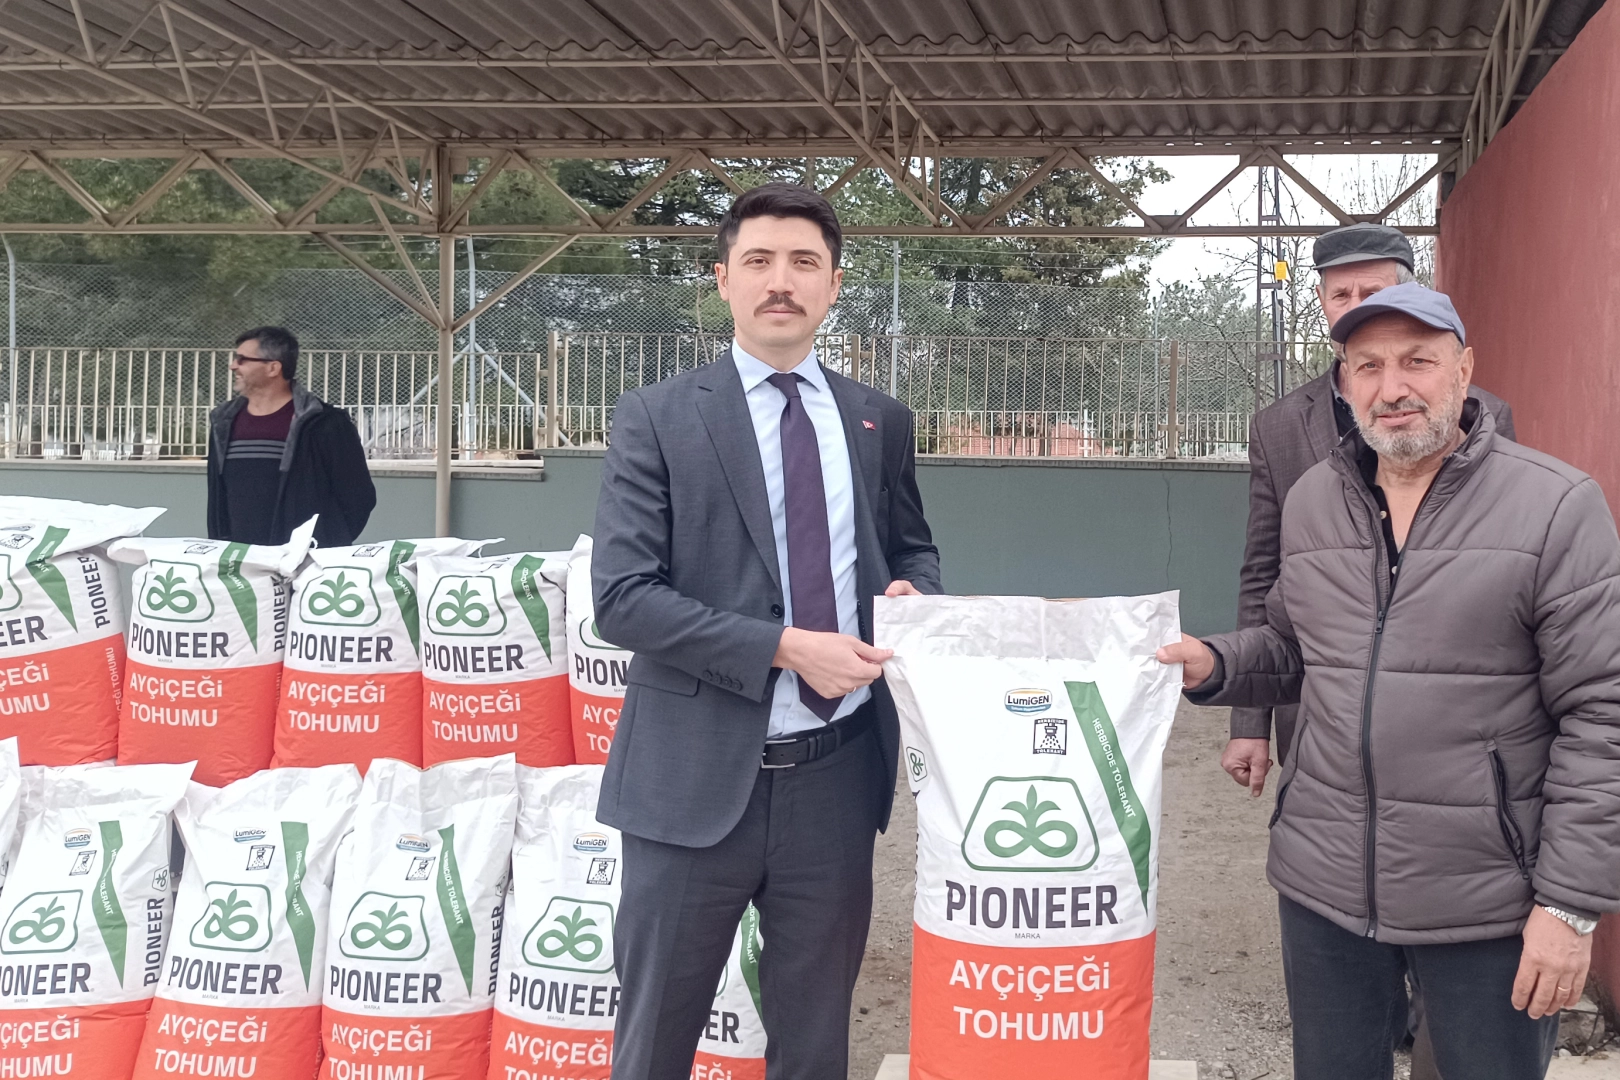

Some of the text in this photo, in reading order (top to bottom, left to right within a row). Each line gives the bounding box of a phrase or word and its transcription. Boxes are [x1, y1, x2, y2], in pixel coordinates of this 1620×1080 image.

[132, 622, 229, 658] PIONEER
[290, 631, 394, 662] PIONEER
[424, 641, 525, 673] PIONEER
[130, 702, 218, 727] TOHUMU
[1008, 695, 1050, 705] LumiGEN
[288, 709, 380, 733] TOHUMU
[432, 720, 518, 742] TOHUMU
[1092, 718, 1136, 818] HERBICIDE TOLERANT
[576, 838, 608, 846] LumiGEN
[447, 886, 464, 924] TOLERANT
[945, 880, 1119, 929] PIONEER
[144, 898, 165, 987] PIONEER
[0, 963, 91, 997] ONEER
[168, 955, 283, 995] PIONEER
[330, 965, 442, 1004] PIONEER
[0, 1014, 80, 1050] ÇiÇEĞi
[953, 1006, 1104, 1041] TOHUMU
[0, 1053, 73, 1079] HUMU
[154, 1048, 258, 1079] TOHUMU
